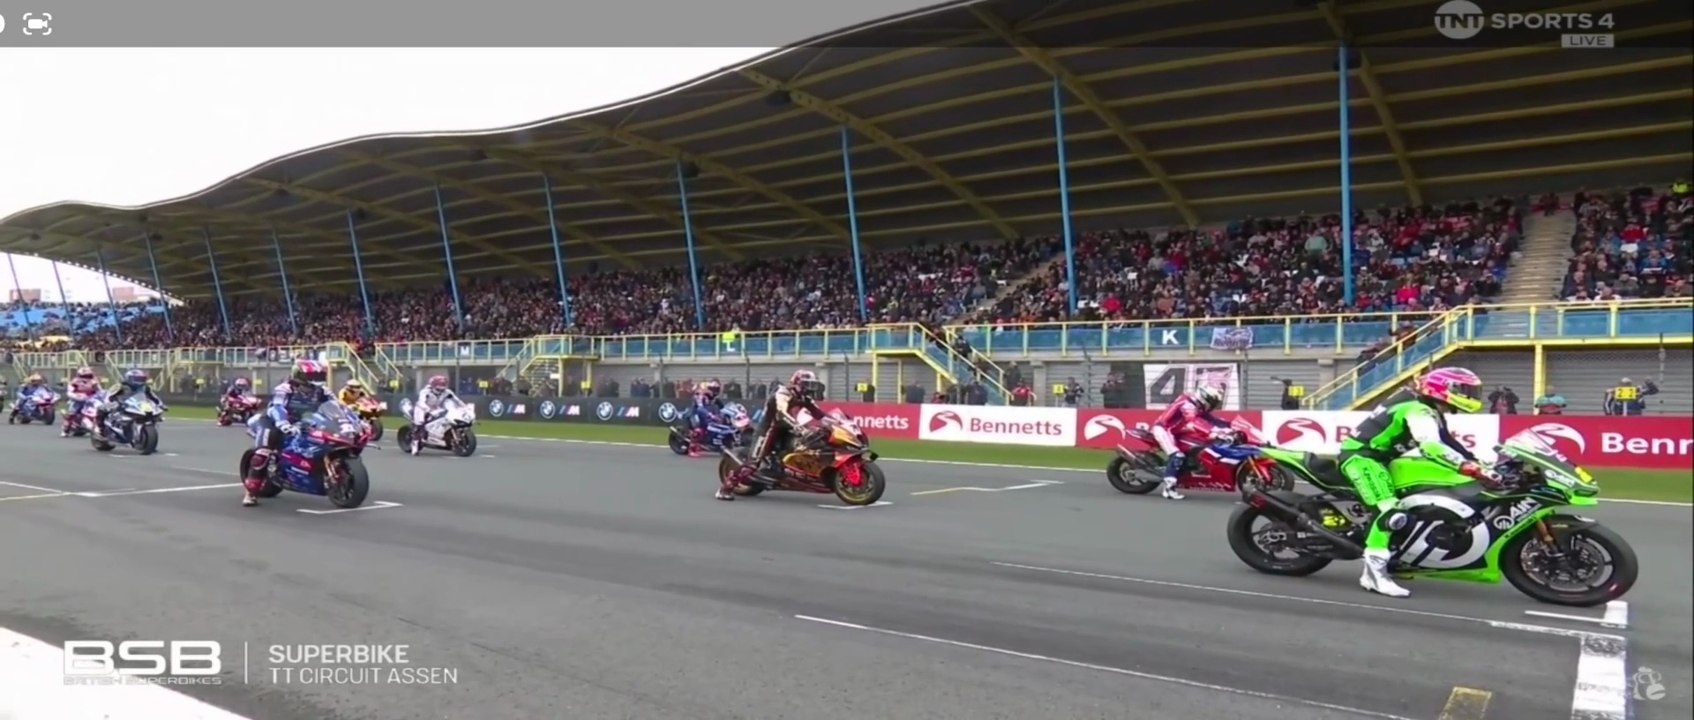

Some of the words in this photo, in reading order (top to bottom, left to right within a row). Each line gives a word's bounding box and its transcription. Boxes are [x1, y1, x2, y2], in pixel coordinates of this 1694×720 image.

[1162, 329, 1179, 345] K
[853, 415, 909, 430] nnetts
[970, 417, 1062, 436] Bennetts
